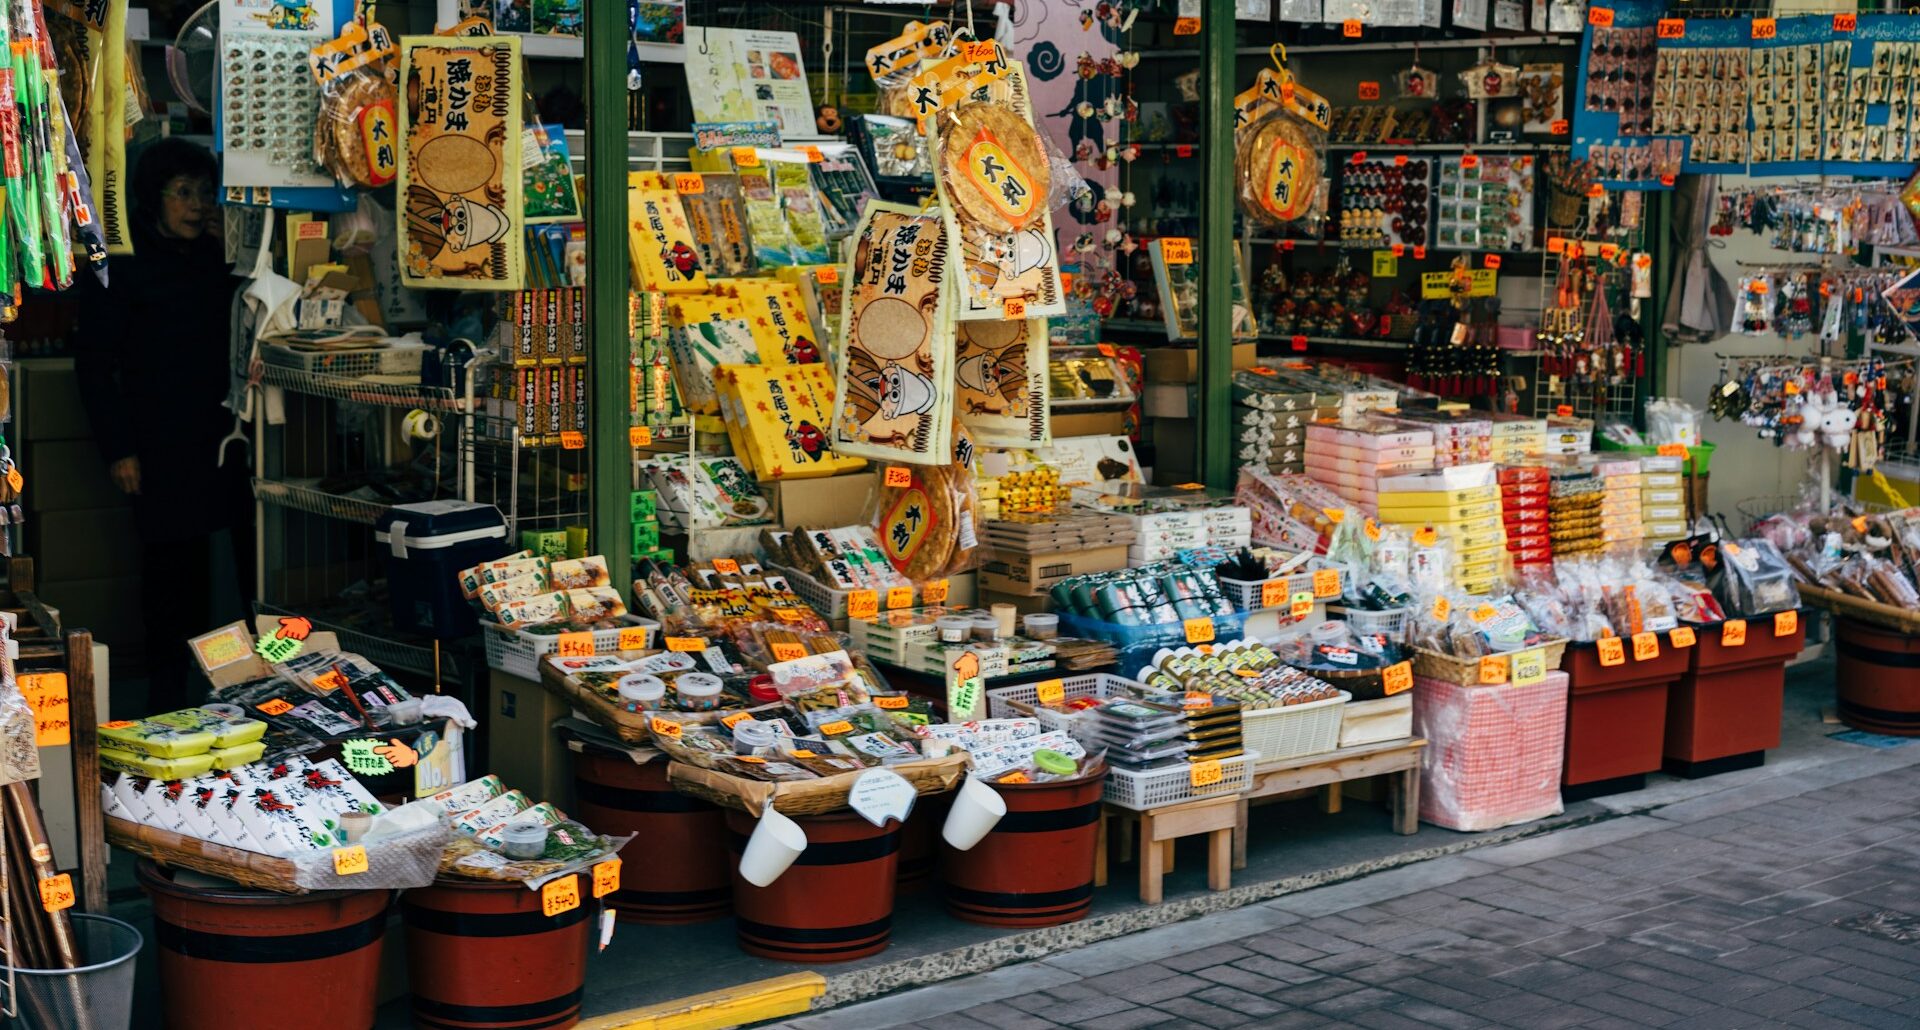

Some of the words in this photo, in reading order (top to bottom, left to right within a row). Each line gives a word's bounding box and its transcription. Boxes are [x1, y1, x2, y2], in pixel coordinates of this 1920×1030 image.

[967, 45, 994, 62] ¥600
[424, 66, 437, 124] 一億円
[444, 58, 473, 132] 焼かま
[371, 117, 394, 169] 大判
[978, 154, 1026, 208] 大判
[1273, 157, 1293, 204] 大判
[563, 640, 594, 657] ¥540
[547, 892, 577, 912] ¥540
